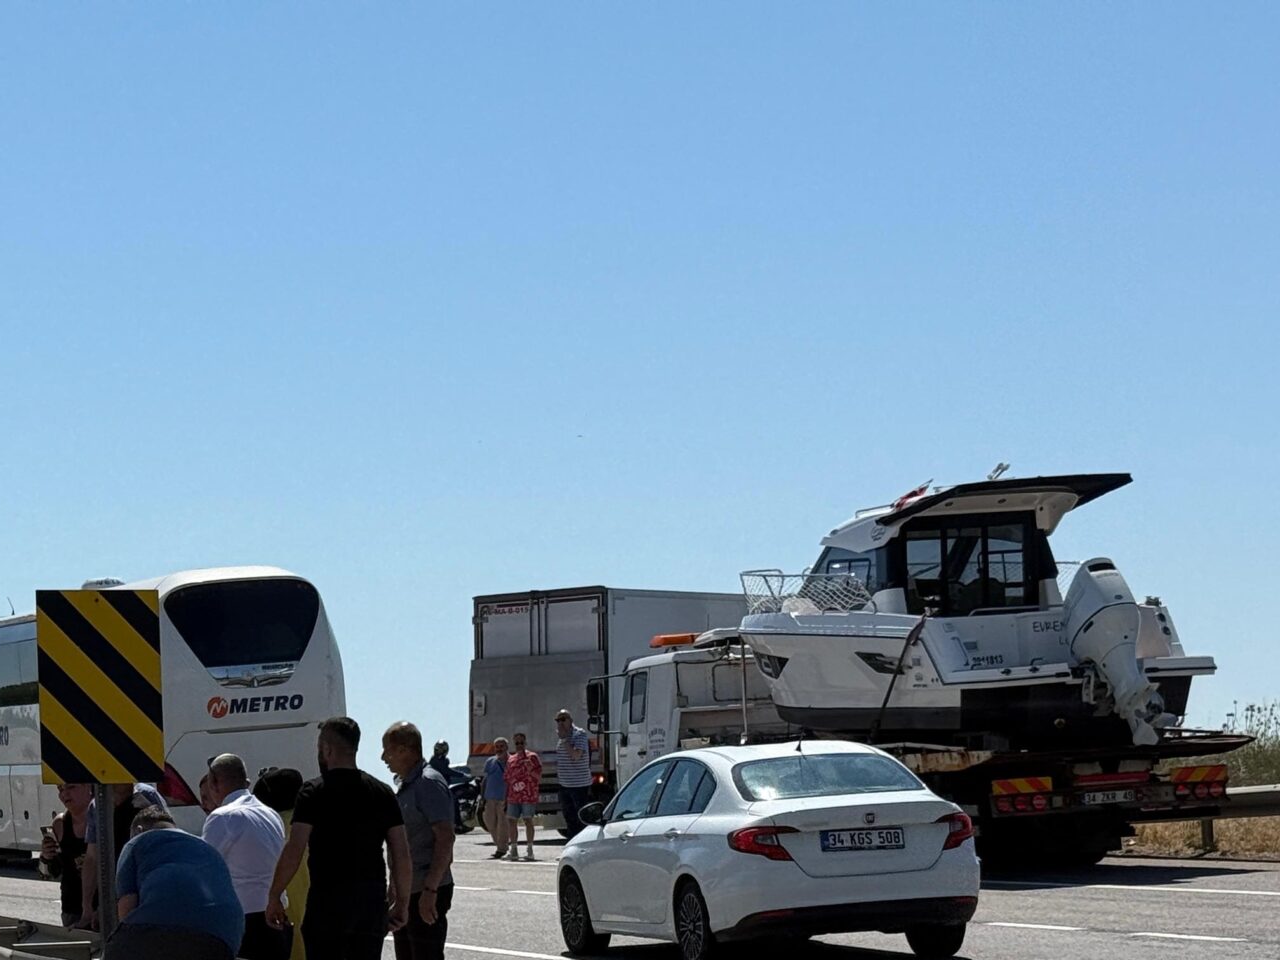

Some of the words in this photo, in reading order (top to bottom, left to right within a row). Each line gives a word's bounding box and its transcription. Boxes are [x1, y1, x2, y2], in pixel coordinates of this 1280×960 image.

[228, 694, 303, 714] METRO
[829, 834, 844, 846] 34
[849, 832, 873, 845] KGS
[878, 831, 900, 844] 508
